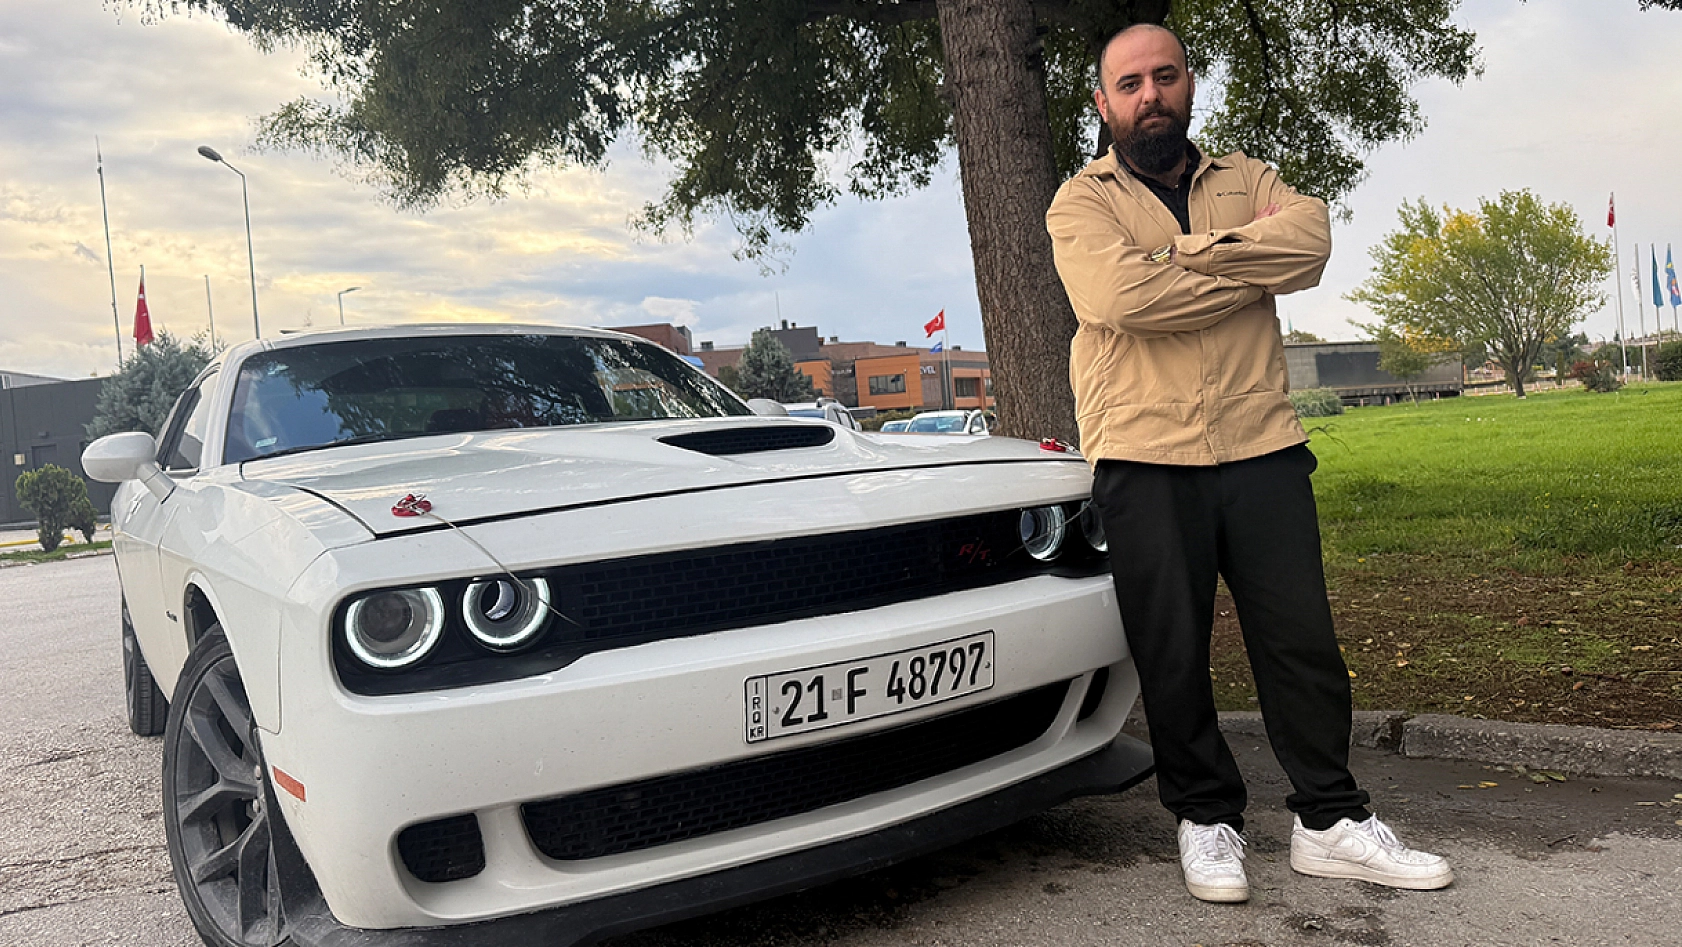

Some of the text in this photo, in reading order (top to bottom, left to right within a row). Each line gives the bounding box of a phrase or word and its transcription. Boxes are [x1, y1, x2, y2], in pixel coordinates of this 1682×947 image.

[958, 540, 991, 563] R/T
[781, 641, 986, 728] 21 F 48797
[749, 725, 765, 739] KR
